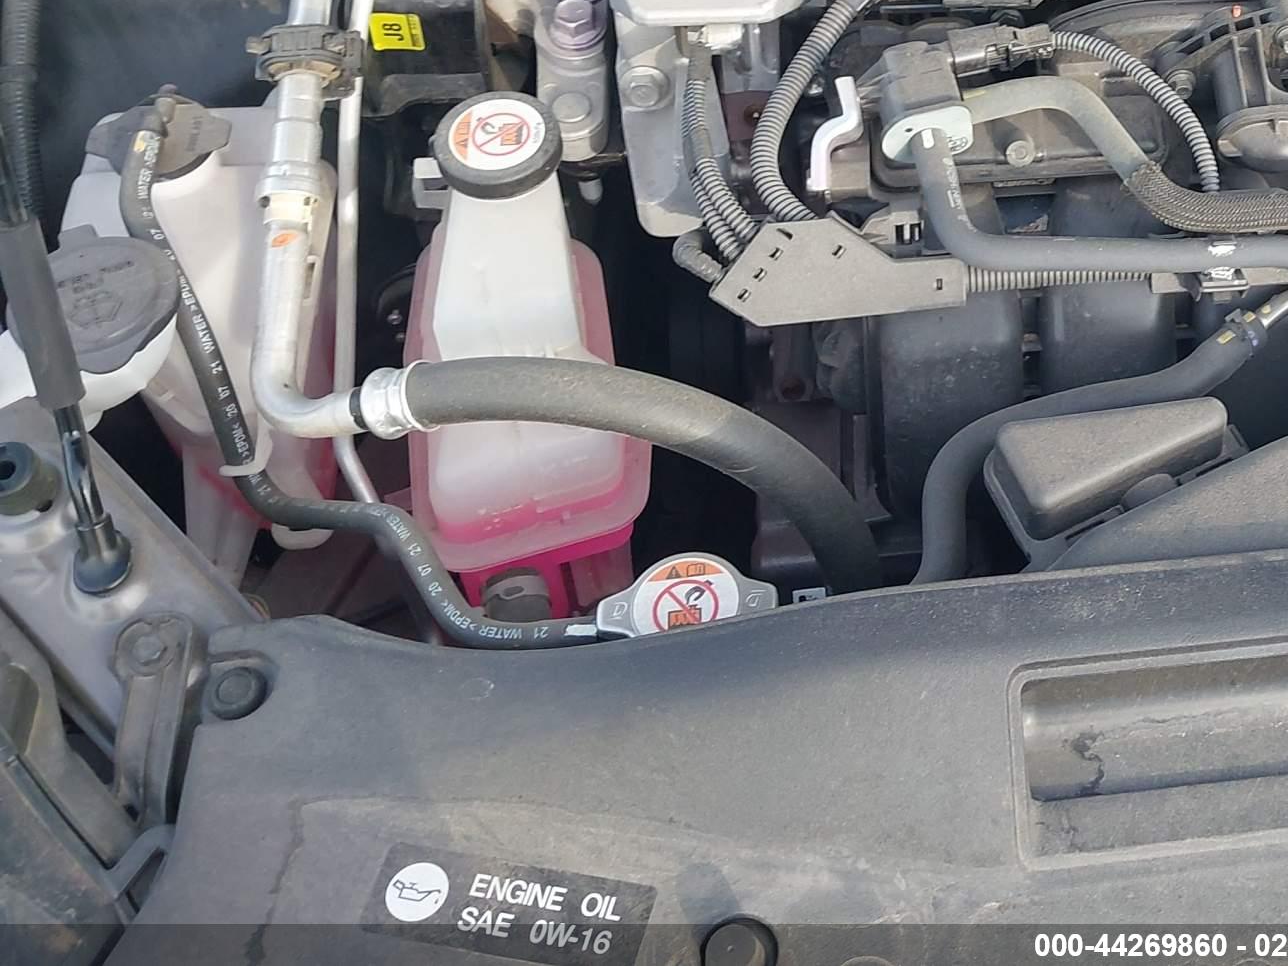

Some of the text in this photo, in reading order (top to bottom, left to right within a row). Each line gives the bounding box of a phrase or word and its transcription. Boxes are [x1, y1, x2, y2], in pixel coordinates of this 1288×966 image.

[382, 23, 404, 41] J8
[192, 313, 216, 354] WATER
[387, 512, 411, 542] WATER
[417, 563, 432, 576] 07
[428, 581, 443, 596] 20
[478, 625, 523, 640] WATER
[532, 626, 549, 639] 21
[469, 873, 621, 922] ENGINE OIL
[457, 906, 613, 955] SAE 0W-16
